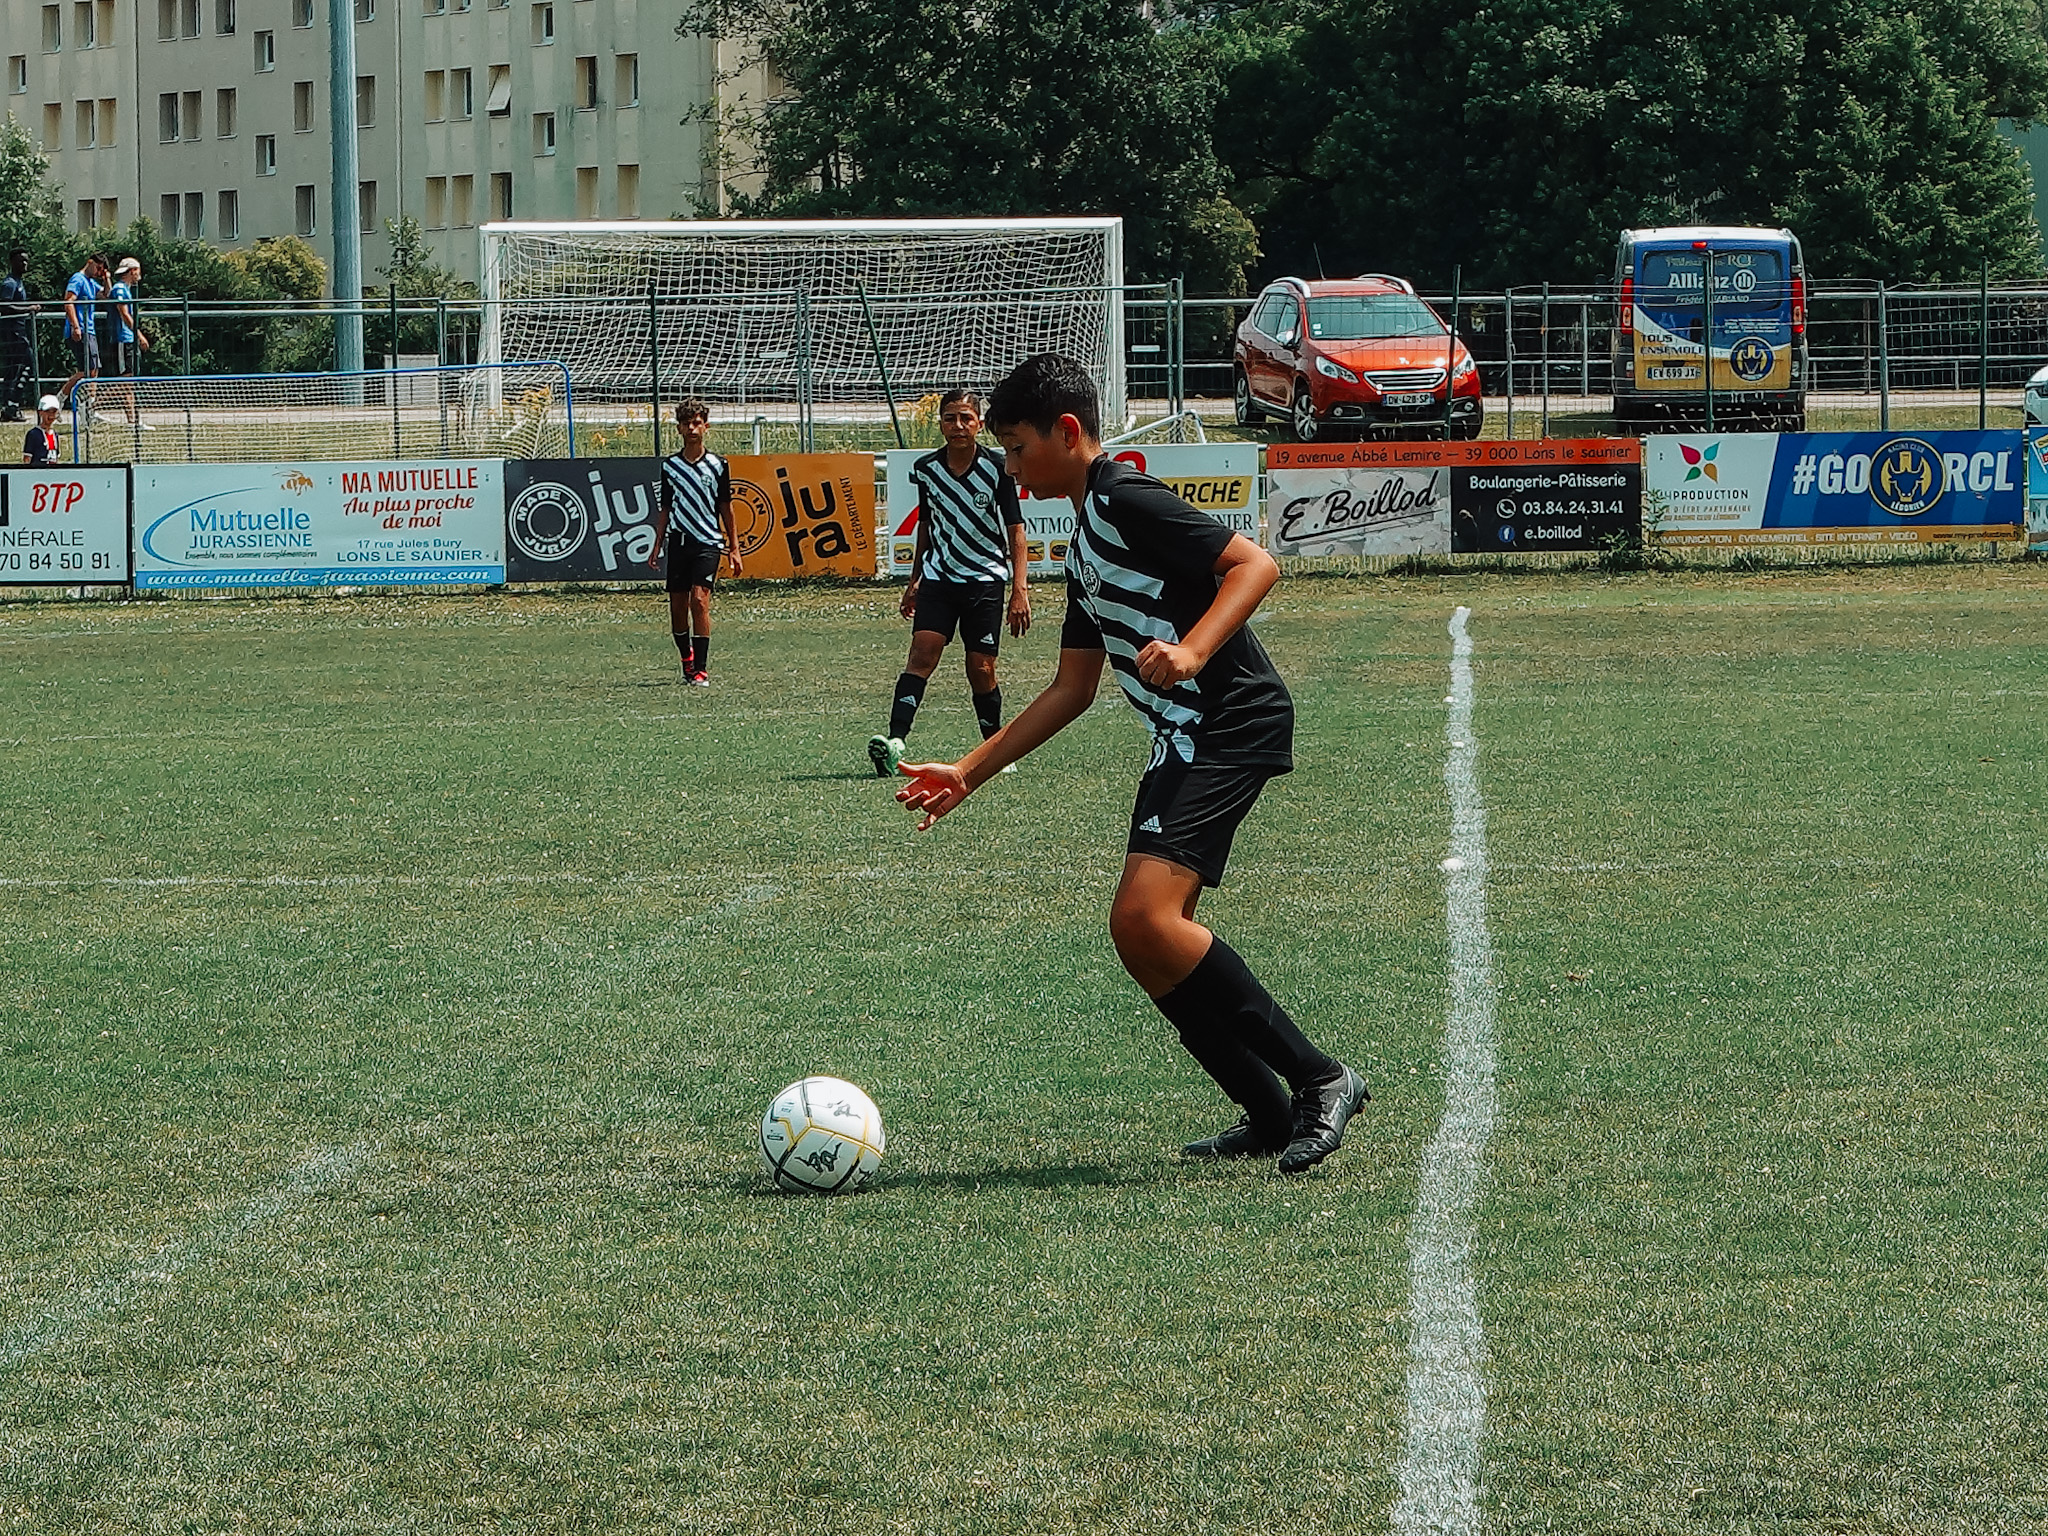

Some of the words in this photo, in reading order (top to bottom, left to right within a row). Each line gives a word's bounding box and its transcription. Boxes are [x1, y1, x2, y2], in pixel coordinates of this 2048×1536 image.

[1276, 451, 1290, 464] 19
[1297, 452, 1345, 463] avenue
[1351, 448, 1388, 462] Abbé
[1394, 449, 1441, 462] Lemire
[1465, 447, 1482, 460] 39
[1489, 447, 1518, 460] 000
[1524, 447, 1555, 460] Lons
[1563, 446, 1575, 459] le
[1581, 447, 1632, 458] saunier
[342, 473, 372, 494] MA
[378, 467, 478, 493] MUTUELLE
[1793, 453, 1872, 495] #GO
[1943, 451, 2014, 491] RCL
[1171, 480, 1242, 503] ARCHÉ
[1469, 473, 1627, 493] Boulangerie-Pâtisserie
[32, 482, 84, 513] BTP
[343, 497, 370, 516] Au
[372, 496, 411, 517] plus
[414, 493, 475, 515] proche
[517, 490, 562, 521] MADE
[564, 500, 580, 520] IN
[588, 470, 649, 533] ju
[775, 467, 836, 528] ju
[1325, 470, 1439, 526] Boillod
[1522, 500, 1624, 516] 03.84.24.31.41
[190, 507, 311, 532] Mutuelle
[383, 513, 404, 529] de
[408, 512, 441, 529] moi
[1027, 516, 1077, 534] NTMO
[2, 527, 84, 547] NÉRALE
[189, 533, 313, 548] JURASSIENNE
[1524, 525, 1583, 540] e.boillod
[1661, 534, 1732, 544] MMUNICATION
[357, 540, 370, 549] 17
[374, 540, 393, 549] rue
[397, 539, 429, 548] Jules
[433, 538, 462, 550] Bury
[524, 536, 571, 554] JURA
[785, 521, 851, 567] ra
[29, 553, 51, 570] 84
[60, 553, 83, 569] 50
[92, 552, 110, 569] 91
[337, 551, 381, 562] LONS
[386, 551, 405, 561] LE
[411, 550, 482, 561] SAUNIER
[147, 568, 490, 585] www.mutuelle-jurassienne.com
